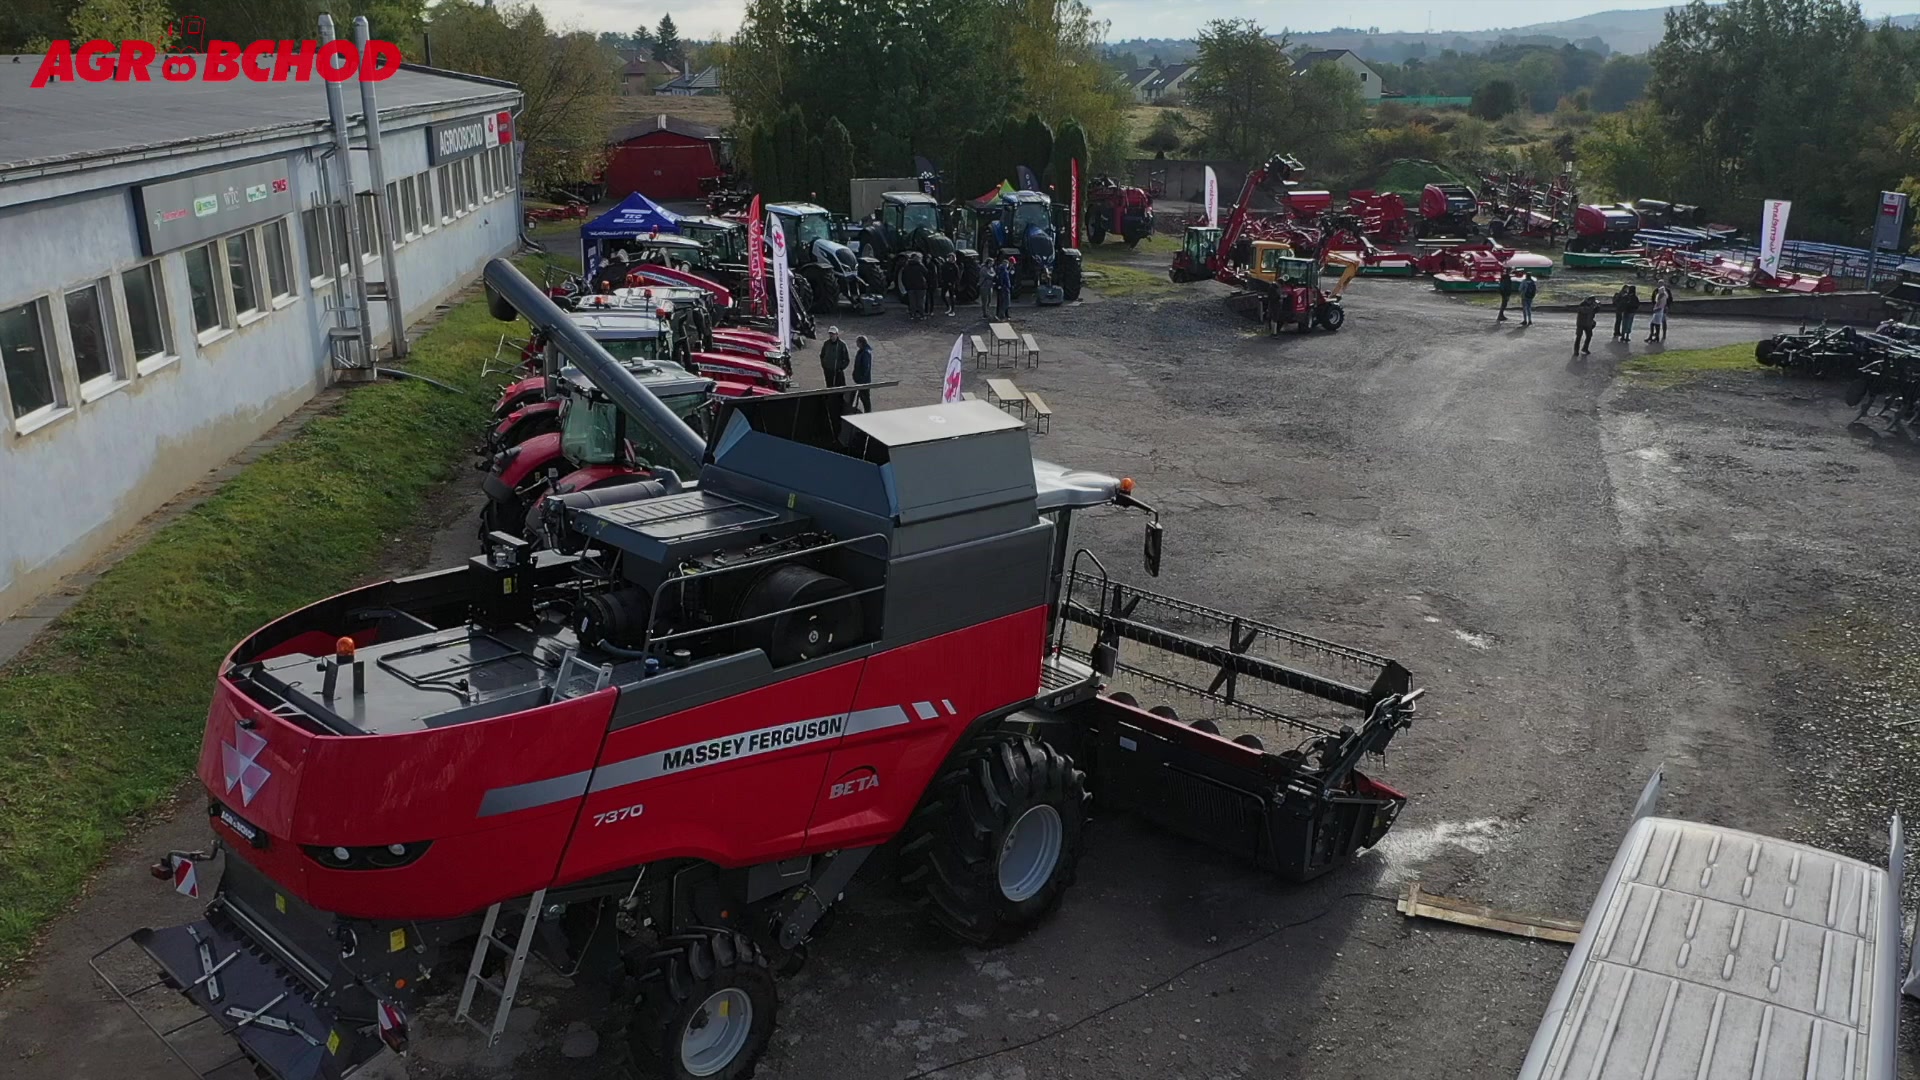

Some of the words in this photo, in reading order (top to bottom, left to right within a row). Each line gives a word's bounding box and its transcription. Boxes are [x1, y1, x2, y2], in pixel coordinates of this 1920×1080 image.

[439, 123, 483, 156] AGROOBCHOD
[662, 737, 745, 771] MASSEY
[749, 717, 842, 749] FERGUSON
[829, 774, 880, 800] BETA
[593, 804, 643, 827] 7370
